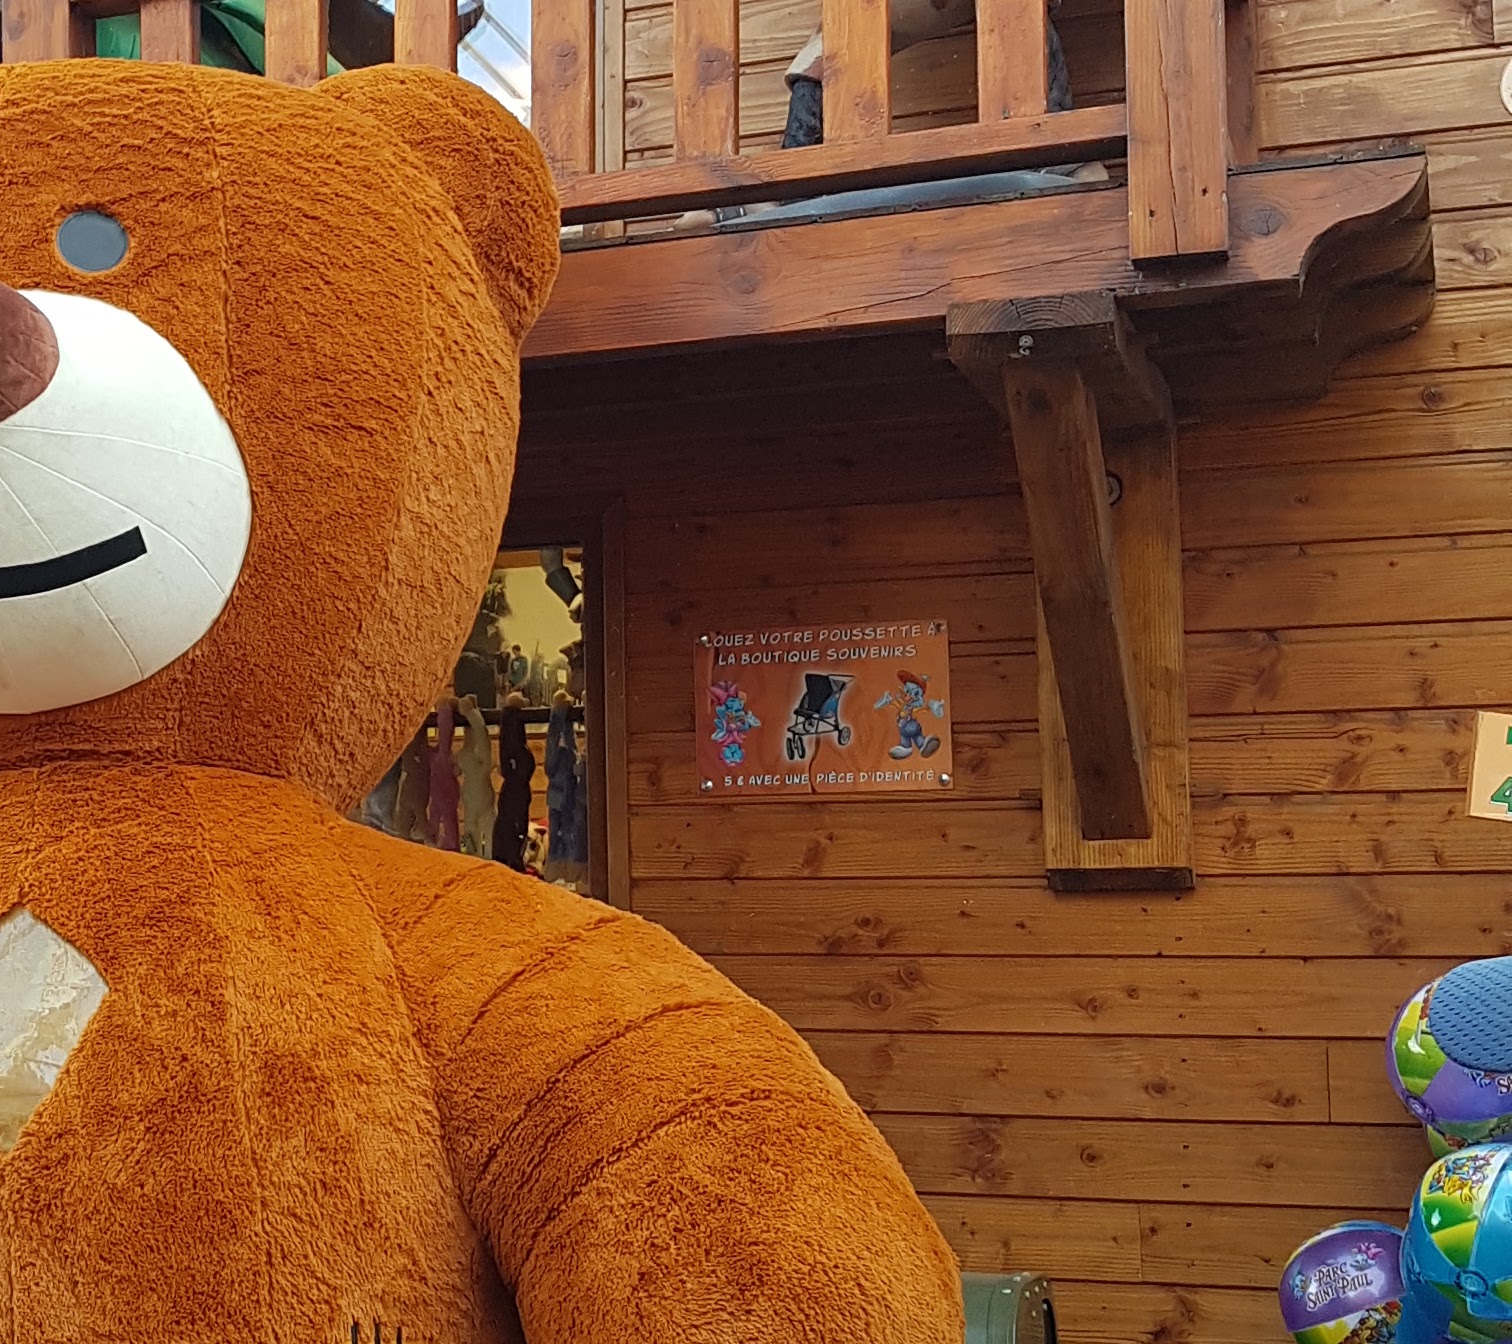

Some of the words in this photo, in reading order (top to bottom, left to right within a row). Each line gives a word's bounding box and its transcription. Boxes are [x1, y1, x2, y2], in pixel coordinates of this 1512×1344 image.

[760, 631, 813, 645] VOTRE
[819, 624, 921, 642] POUSSETTE
[719, 652, 735, 666] LA
[741, 649, 820, 665] BOUTIQUE
[826, 644, 917, 661] SOUVENIRS
[724, 776, 733, 786] 5
[749, 774, 781, 786] AVEC
[785, 773, 809, 785] UNE
[817, 771, 854, 784] PIÈCE
[859, 768, 935, 783] D'IDENTITÉ
[1314, 1262, 1347, 1286] PARC
[1307, 1284, 1336, 1310] SAINT
[1337, 1273, 1373, 1295] PAUL
